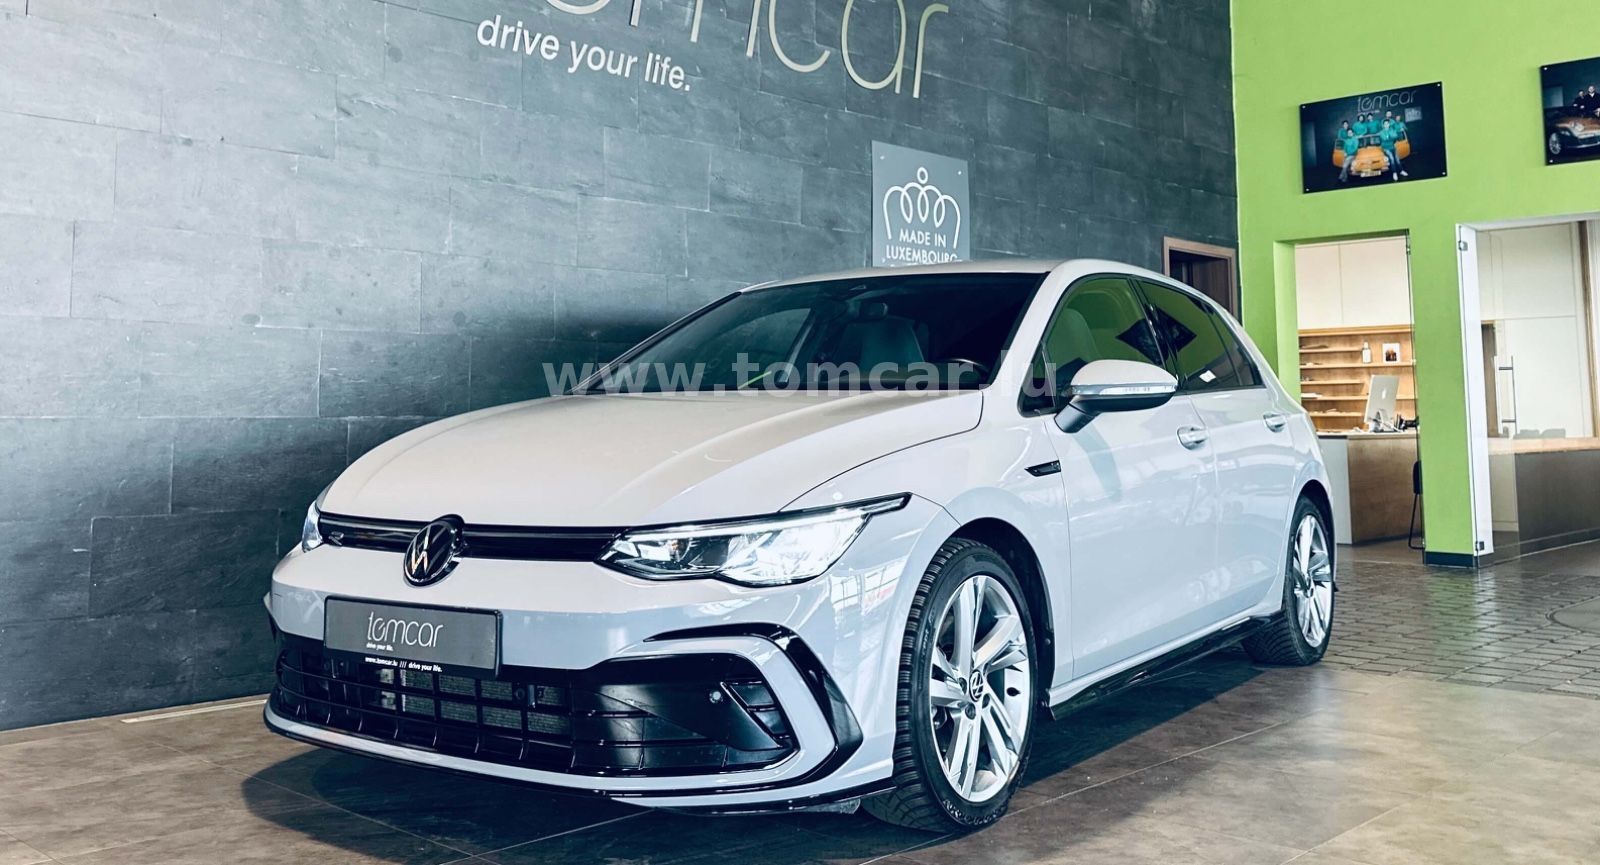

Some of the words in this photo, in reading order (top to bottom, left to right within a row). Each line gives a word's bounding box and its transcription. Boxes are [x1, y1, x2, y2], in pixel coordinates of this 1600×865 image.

[476, 14, 560, 61] drive
[567, 40, 638, 78] your
[644, 52, 691, 92] life.
[546, 0, 949, 99] car
[899, 228, 931, 246] MADE
[934, 232, 947, 248] IN
[367, 611, 443, 648] tomcar
